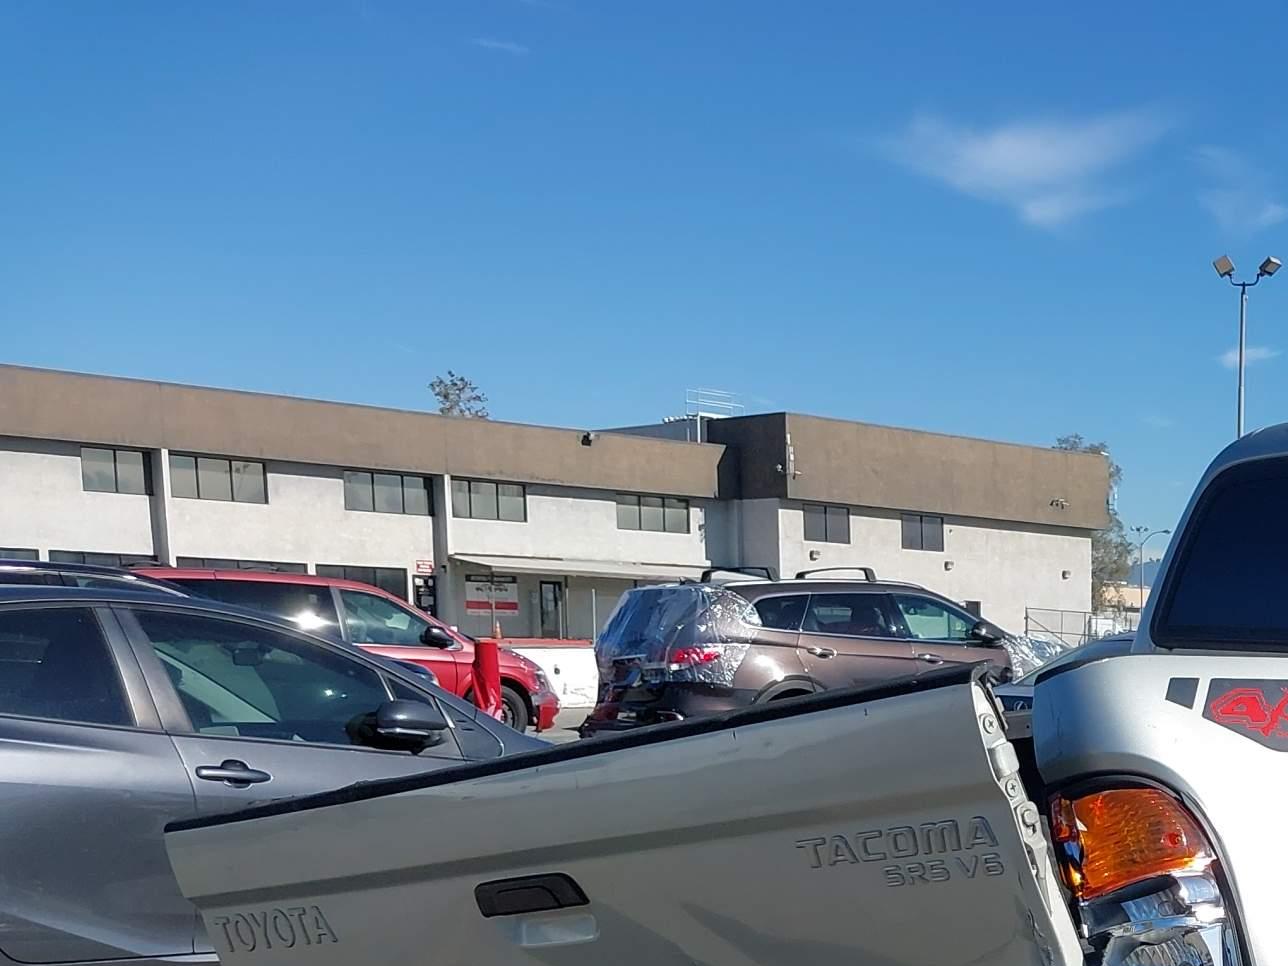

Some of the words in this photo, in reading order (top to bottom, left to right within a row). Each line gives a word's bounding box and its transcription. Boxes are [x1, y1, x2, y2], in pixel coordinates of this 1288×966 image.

[795, 815, 999, 869] TACOMA
[883, 859, 951, 887] SR5
[954, 852, 1005, 879] V6
[214, 905, 338, 953] TOYOTA
